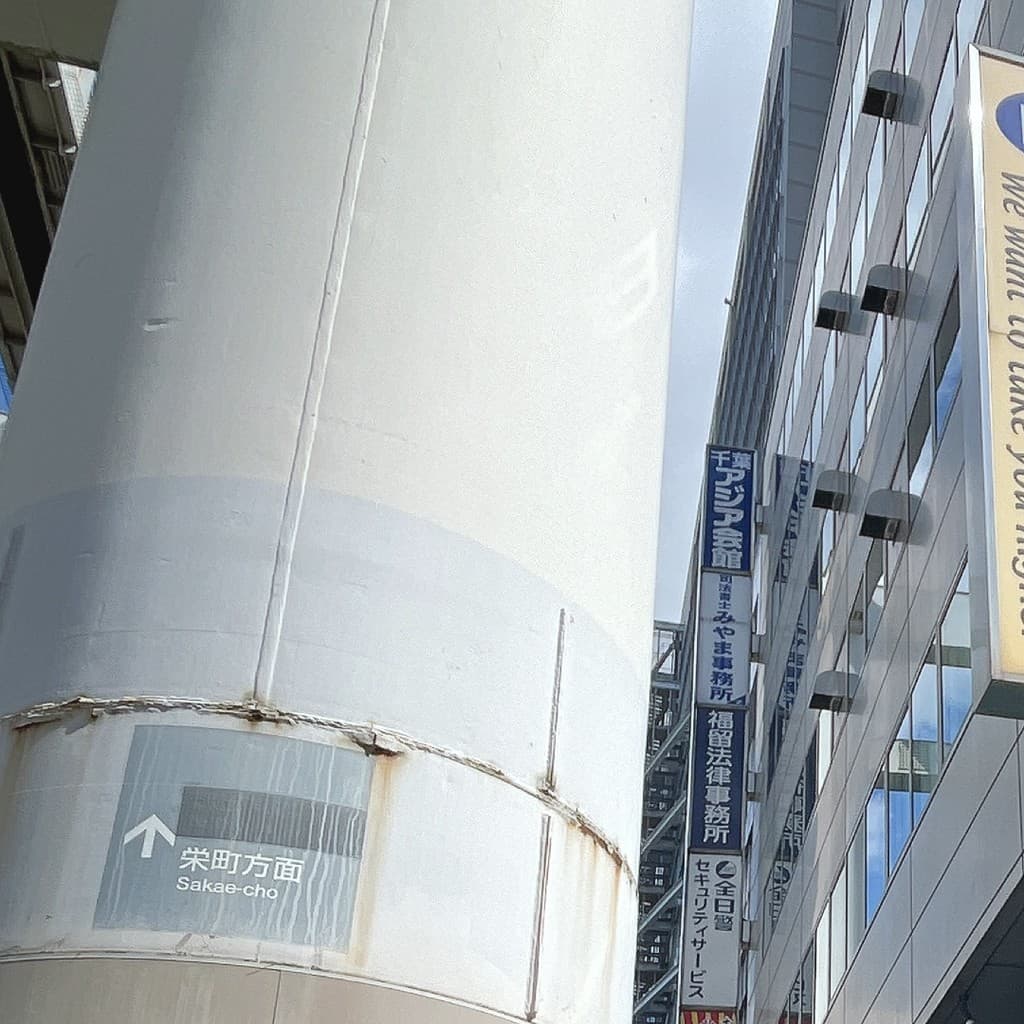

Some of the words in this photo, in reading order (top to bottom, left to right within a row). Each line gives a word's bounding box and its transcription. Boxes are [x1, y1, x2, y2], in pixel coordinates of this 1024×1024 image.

[703, 709, 735, 845] 福留法律事務所
[176, 876, 279, 900] Sakae-cho
[179, 847, 304, 884] 栄町方面
[688, 859, 711, 999] セキュリティサービス
[714, 881, 736, 931] 全日警
